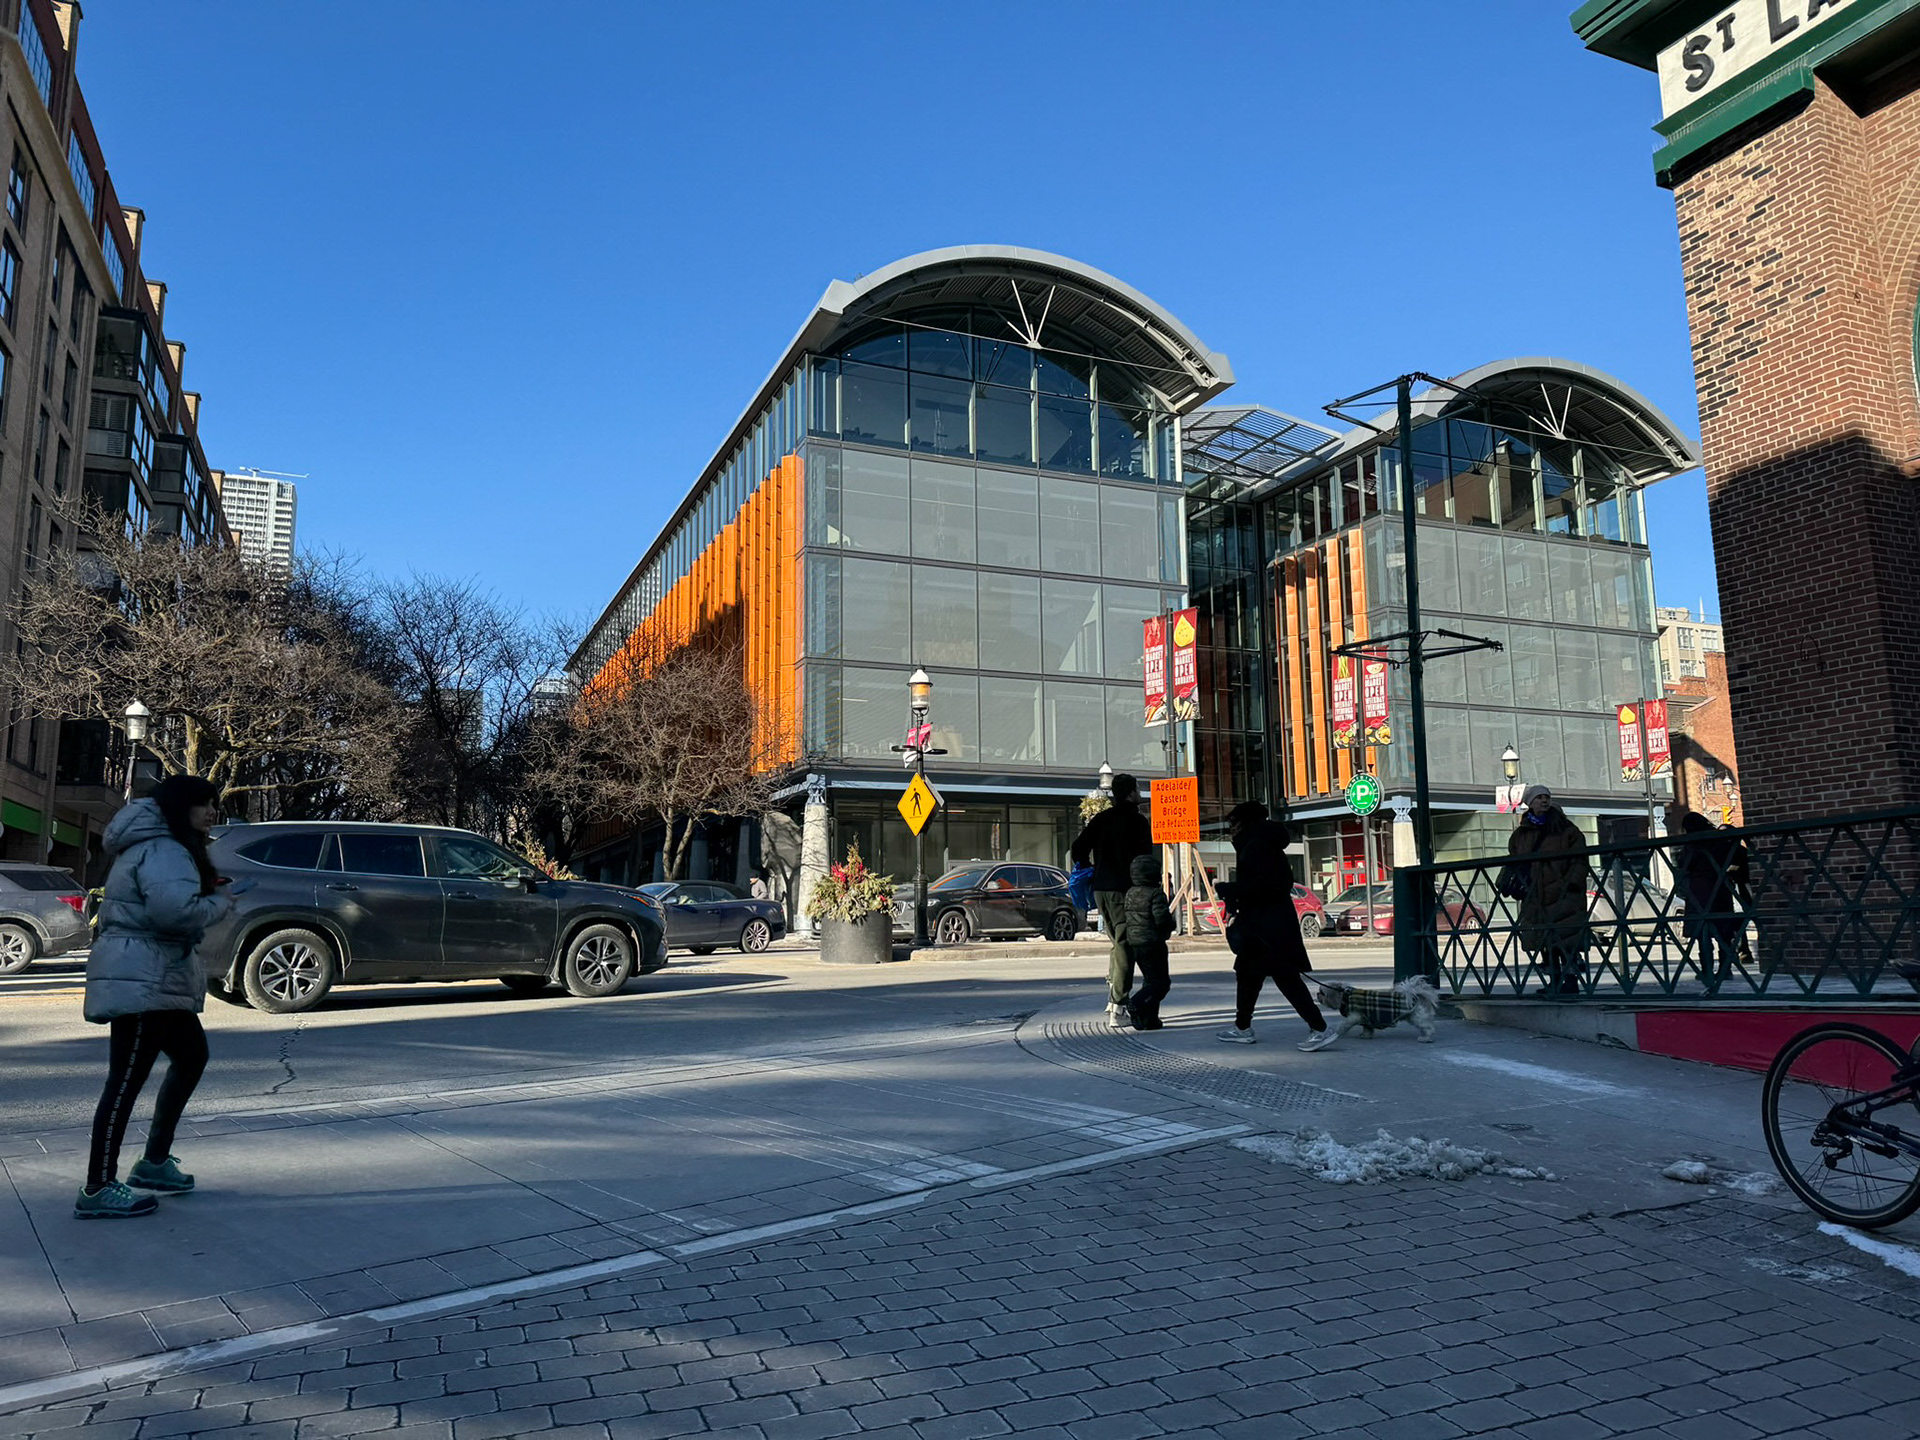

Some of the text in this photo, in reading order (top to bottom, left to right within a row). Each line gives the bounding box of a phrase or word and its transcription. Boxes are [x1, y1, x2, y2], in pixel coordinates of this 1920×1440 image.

[1146, 659, 1163, 674] OPEN
[1175, 663, 1194, 678] OPEN
[1334, 690, 1353, 702] OPEN
[1365, 686, 1385, 698] OPEN
[1649, 738, 1667, 748] OPEN
[1156, 780, 1192, 792] Adelaide/
[1160, 794, 1187, 804] Eastern
[1357, 785, 1369, 801] P
[1162, 806, 1187, 818] Bridge
